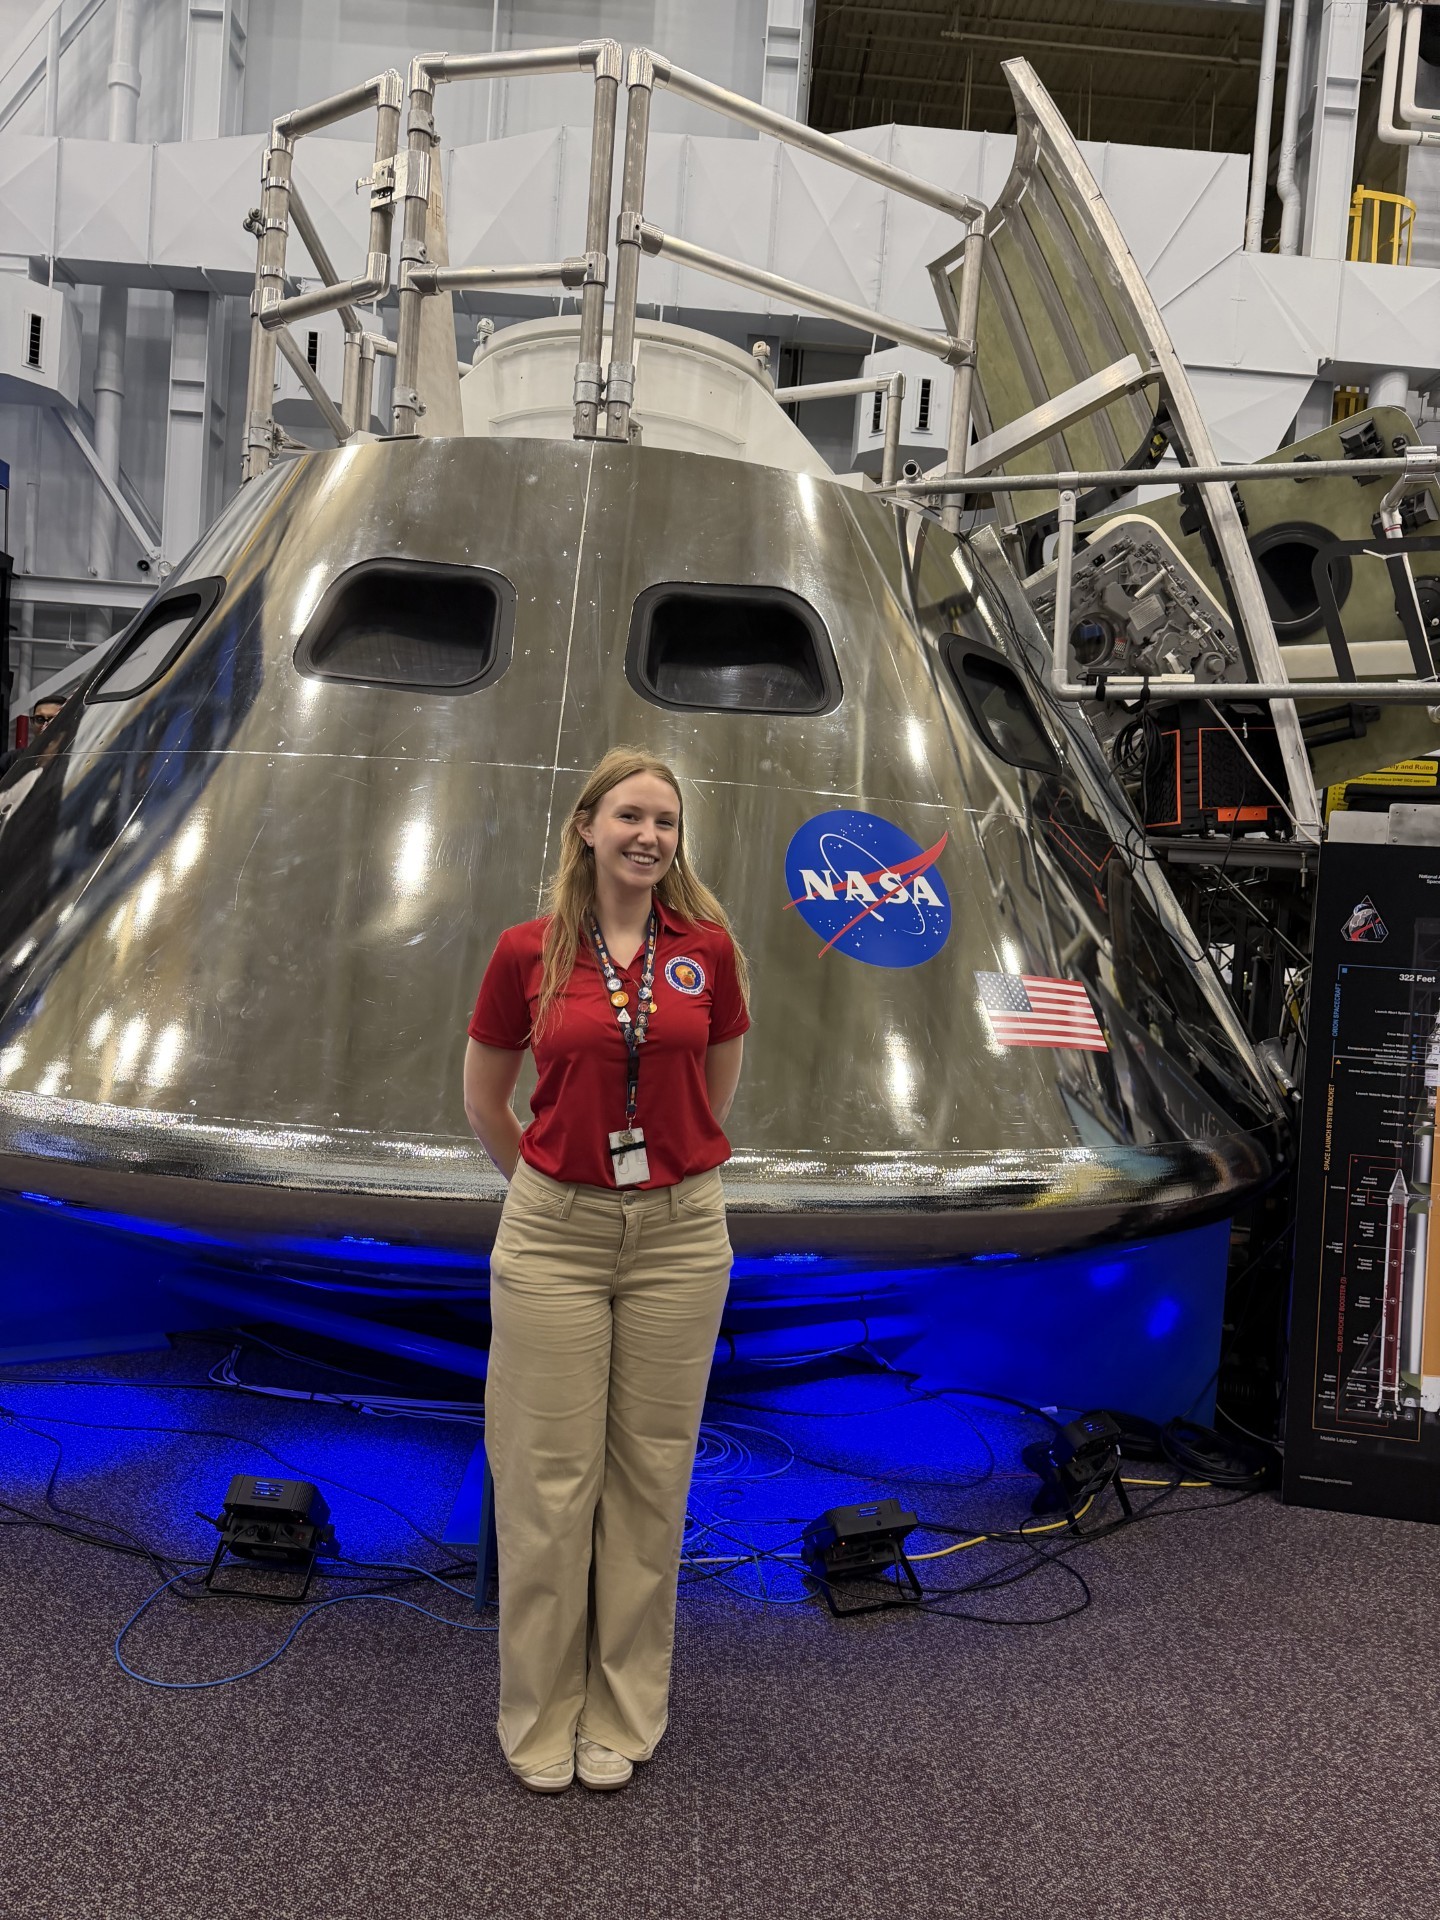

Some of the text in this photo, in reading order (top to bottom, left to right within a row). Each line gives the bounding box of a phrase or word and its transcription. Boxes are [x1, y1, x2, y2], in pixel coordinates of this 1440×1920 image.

[799, 869, 945, 907] NASA
[1399, 973, 1436, 983] 322 Feet
[1331, 982, 1341, 1037] ORION SPACECRAFT
[1323, 1083, 1335, 1171] SPACE LAUNCH SYSTEM ROCKET
[1337, 1312, 1345, 1336] ROCKET
[1336, 1336, 1344, 1353] SOLID
[1336, 1437, 1358, 1445] Launcher
